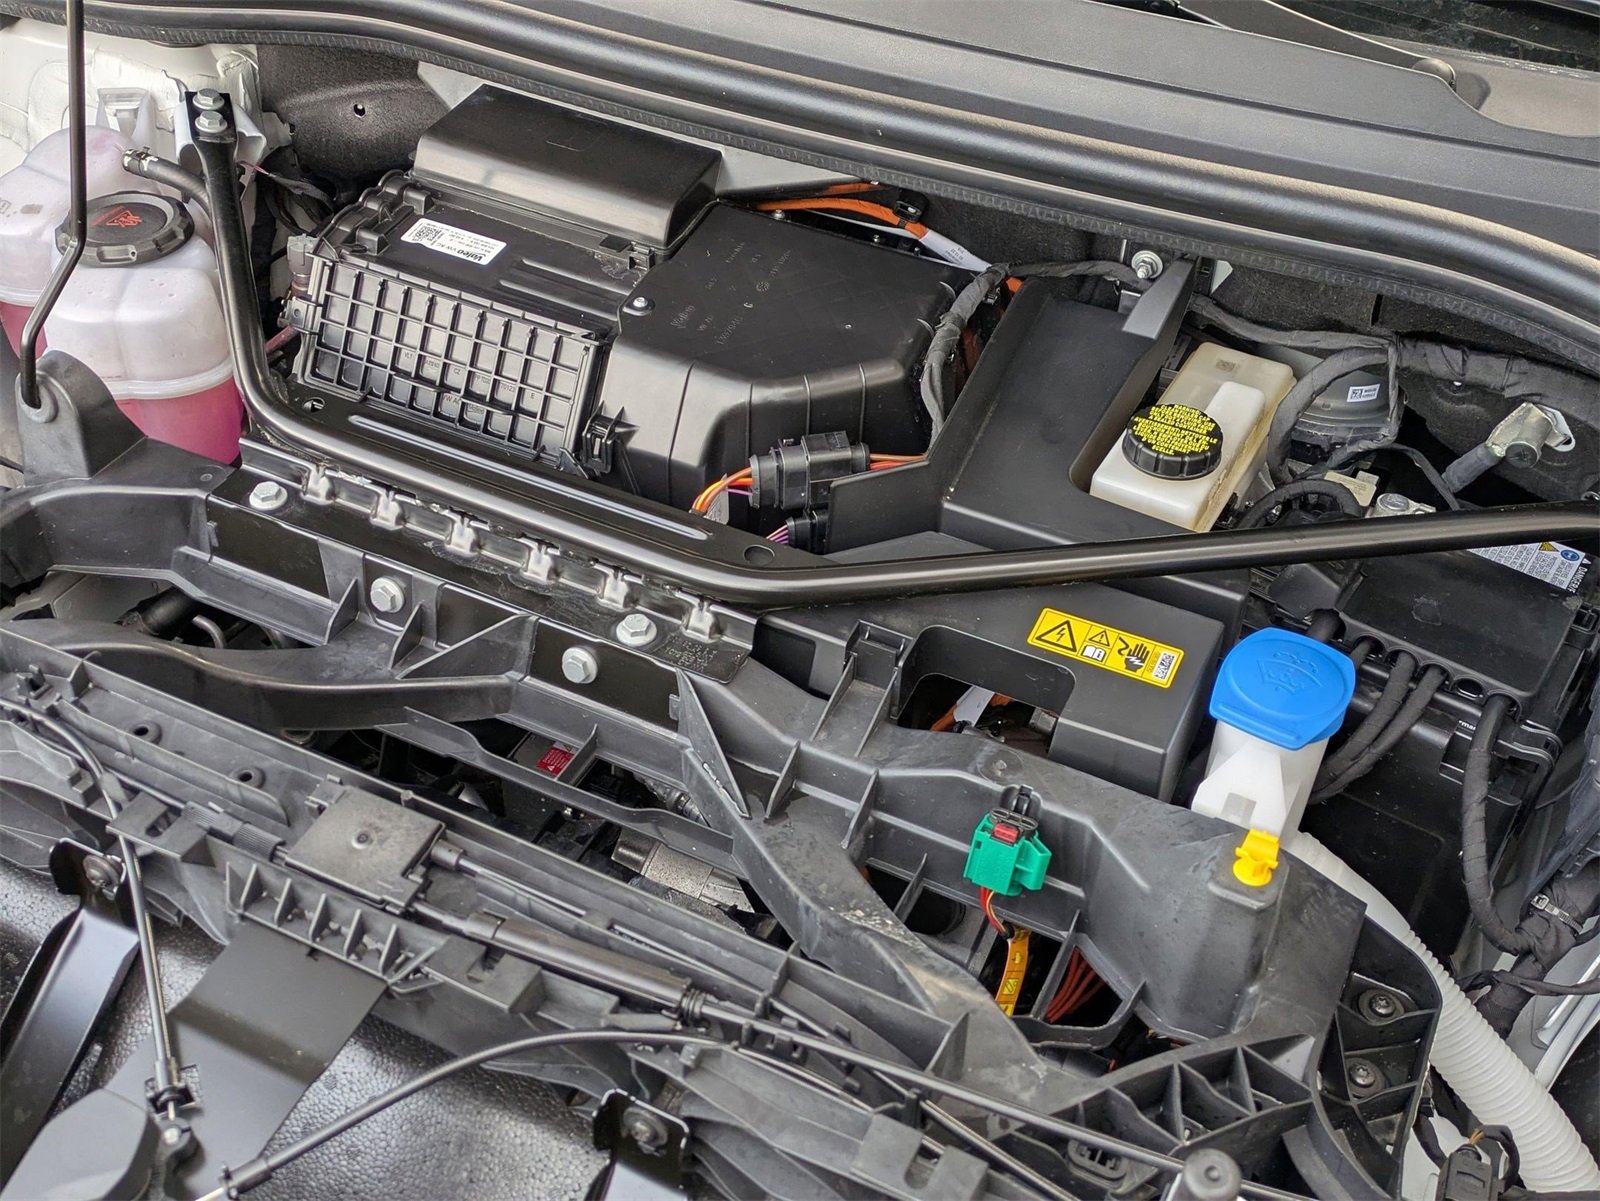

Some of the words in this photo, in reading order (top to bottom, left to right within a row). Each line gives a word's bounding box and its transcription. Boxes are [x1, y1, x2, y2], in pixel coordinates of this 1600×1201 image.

[457, 249, 483, 261] Valeo
[1151, 406, 1172, 415] BEFORE
[1160, 404, 1178, 412] CLEAN
[1178, 409, 1198, 418] FILLER
[1153, 416, 1174, 425] SEALED
[1137, 422, 1165, 433] BOUCHON
[1165, 430, 1184, 438] AVANT
[1197, 423, 1212, 431] FROM
[1134, 430, 1156, 439] LIQUIDE
[1170, 440, 1202, 452] PROVENANT
[1180, 429, 1209, 441] NETTOYER
[1156, 441, 1190, 453] CONTENANT
